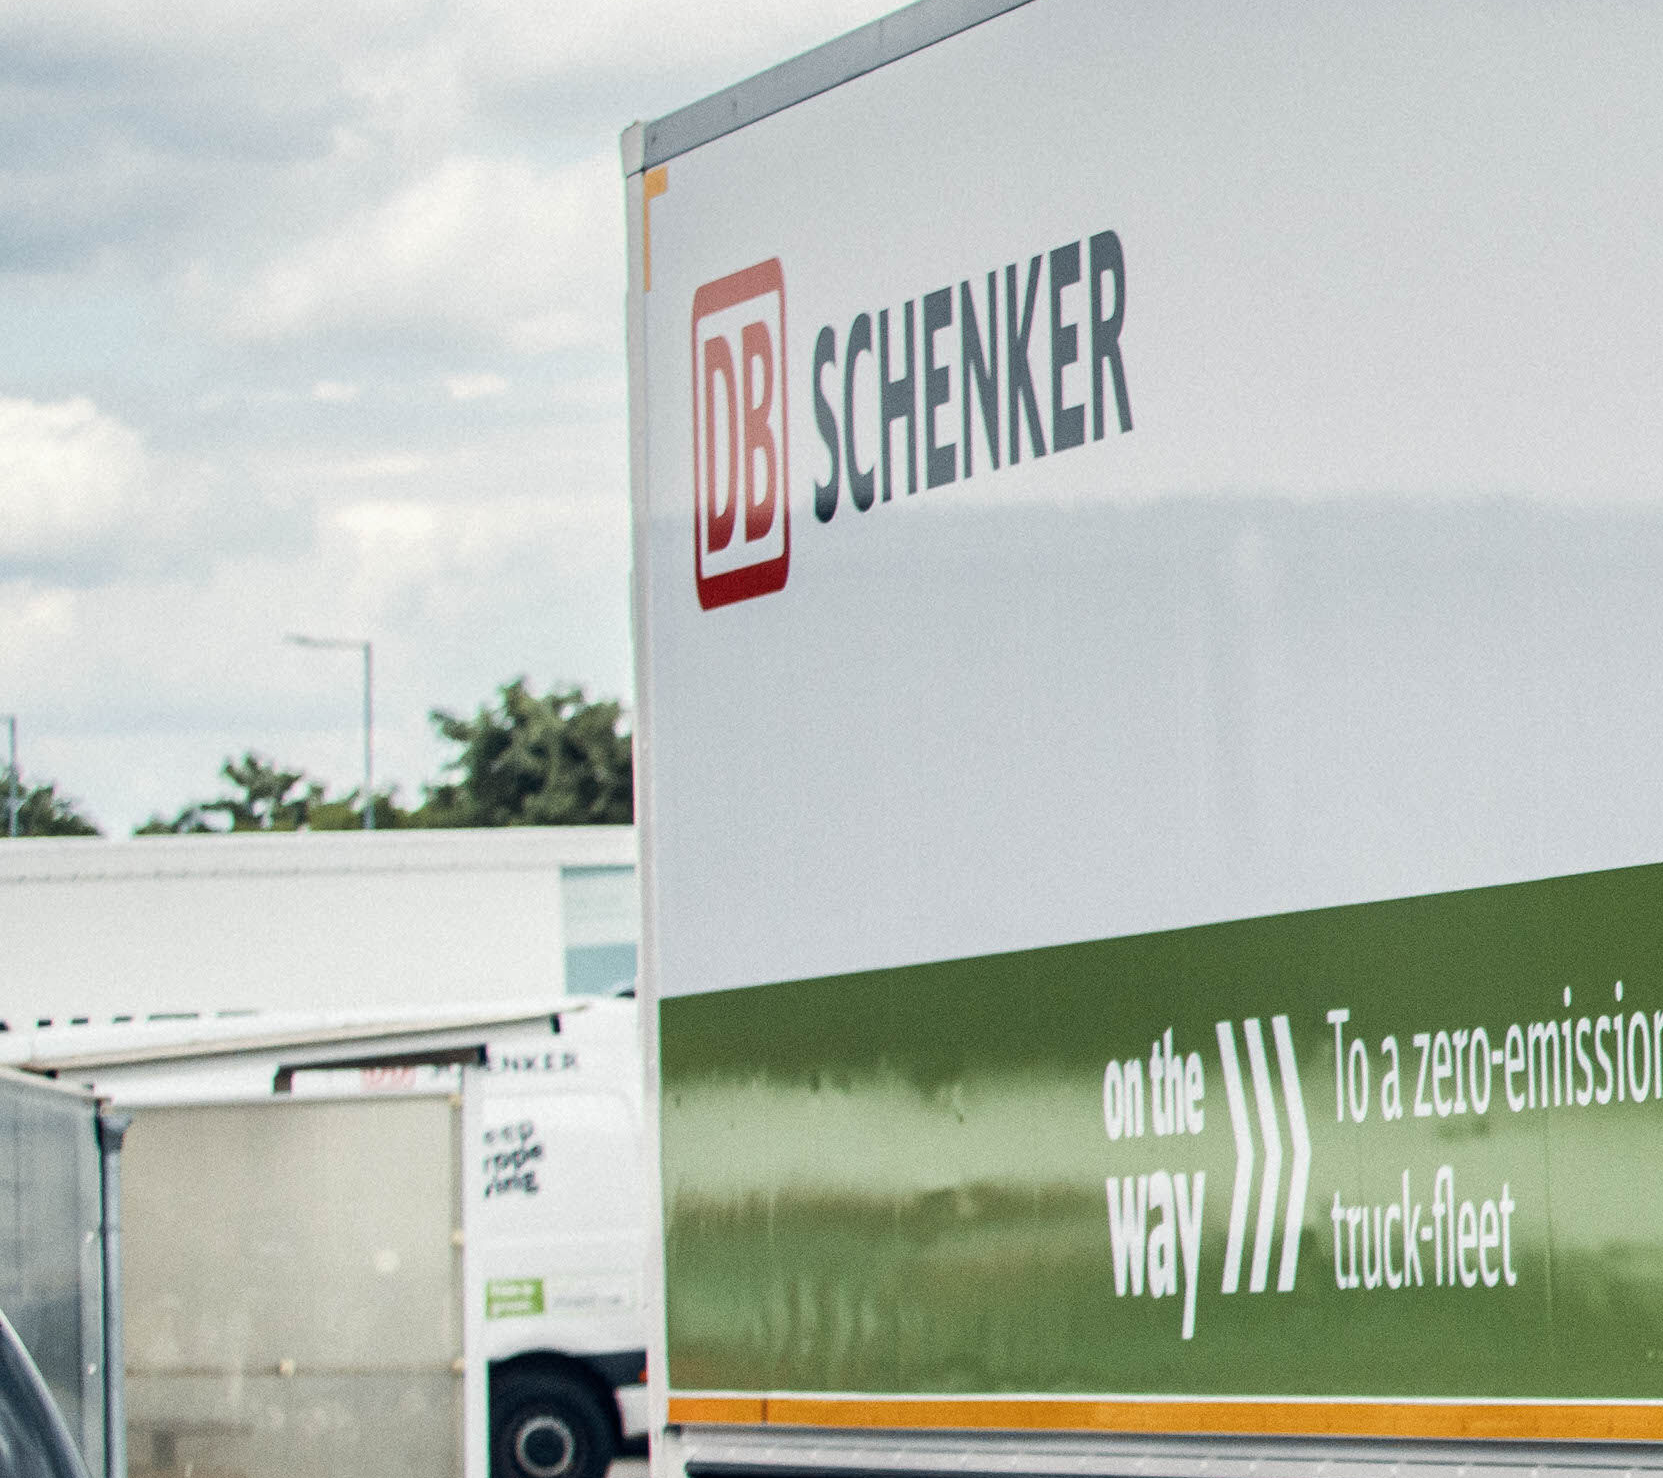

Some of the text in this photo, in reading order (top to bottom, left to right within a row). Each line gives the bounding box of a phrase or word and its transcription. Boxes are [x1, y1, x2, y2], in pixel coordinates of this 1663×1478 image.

[700, 228, 1133, 558] DB SCHENKER
[1103, 1026, 1205, 1140] on the
[1327, 1008, 1370, 1124] To
[1380, 1034, 1403, 1120] a
[1105, 1170, 1206, 1340] way
[1330, 1164, 1517, 1290] truck-fleet
